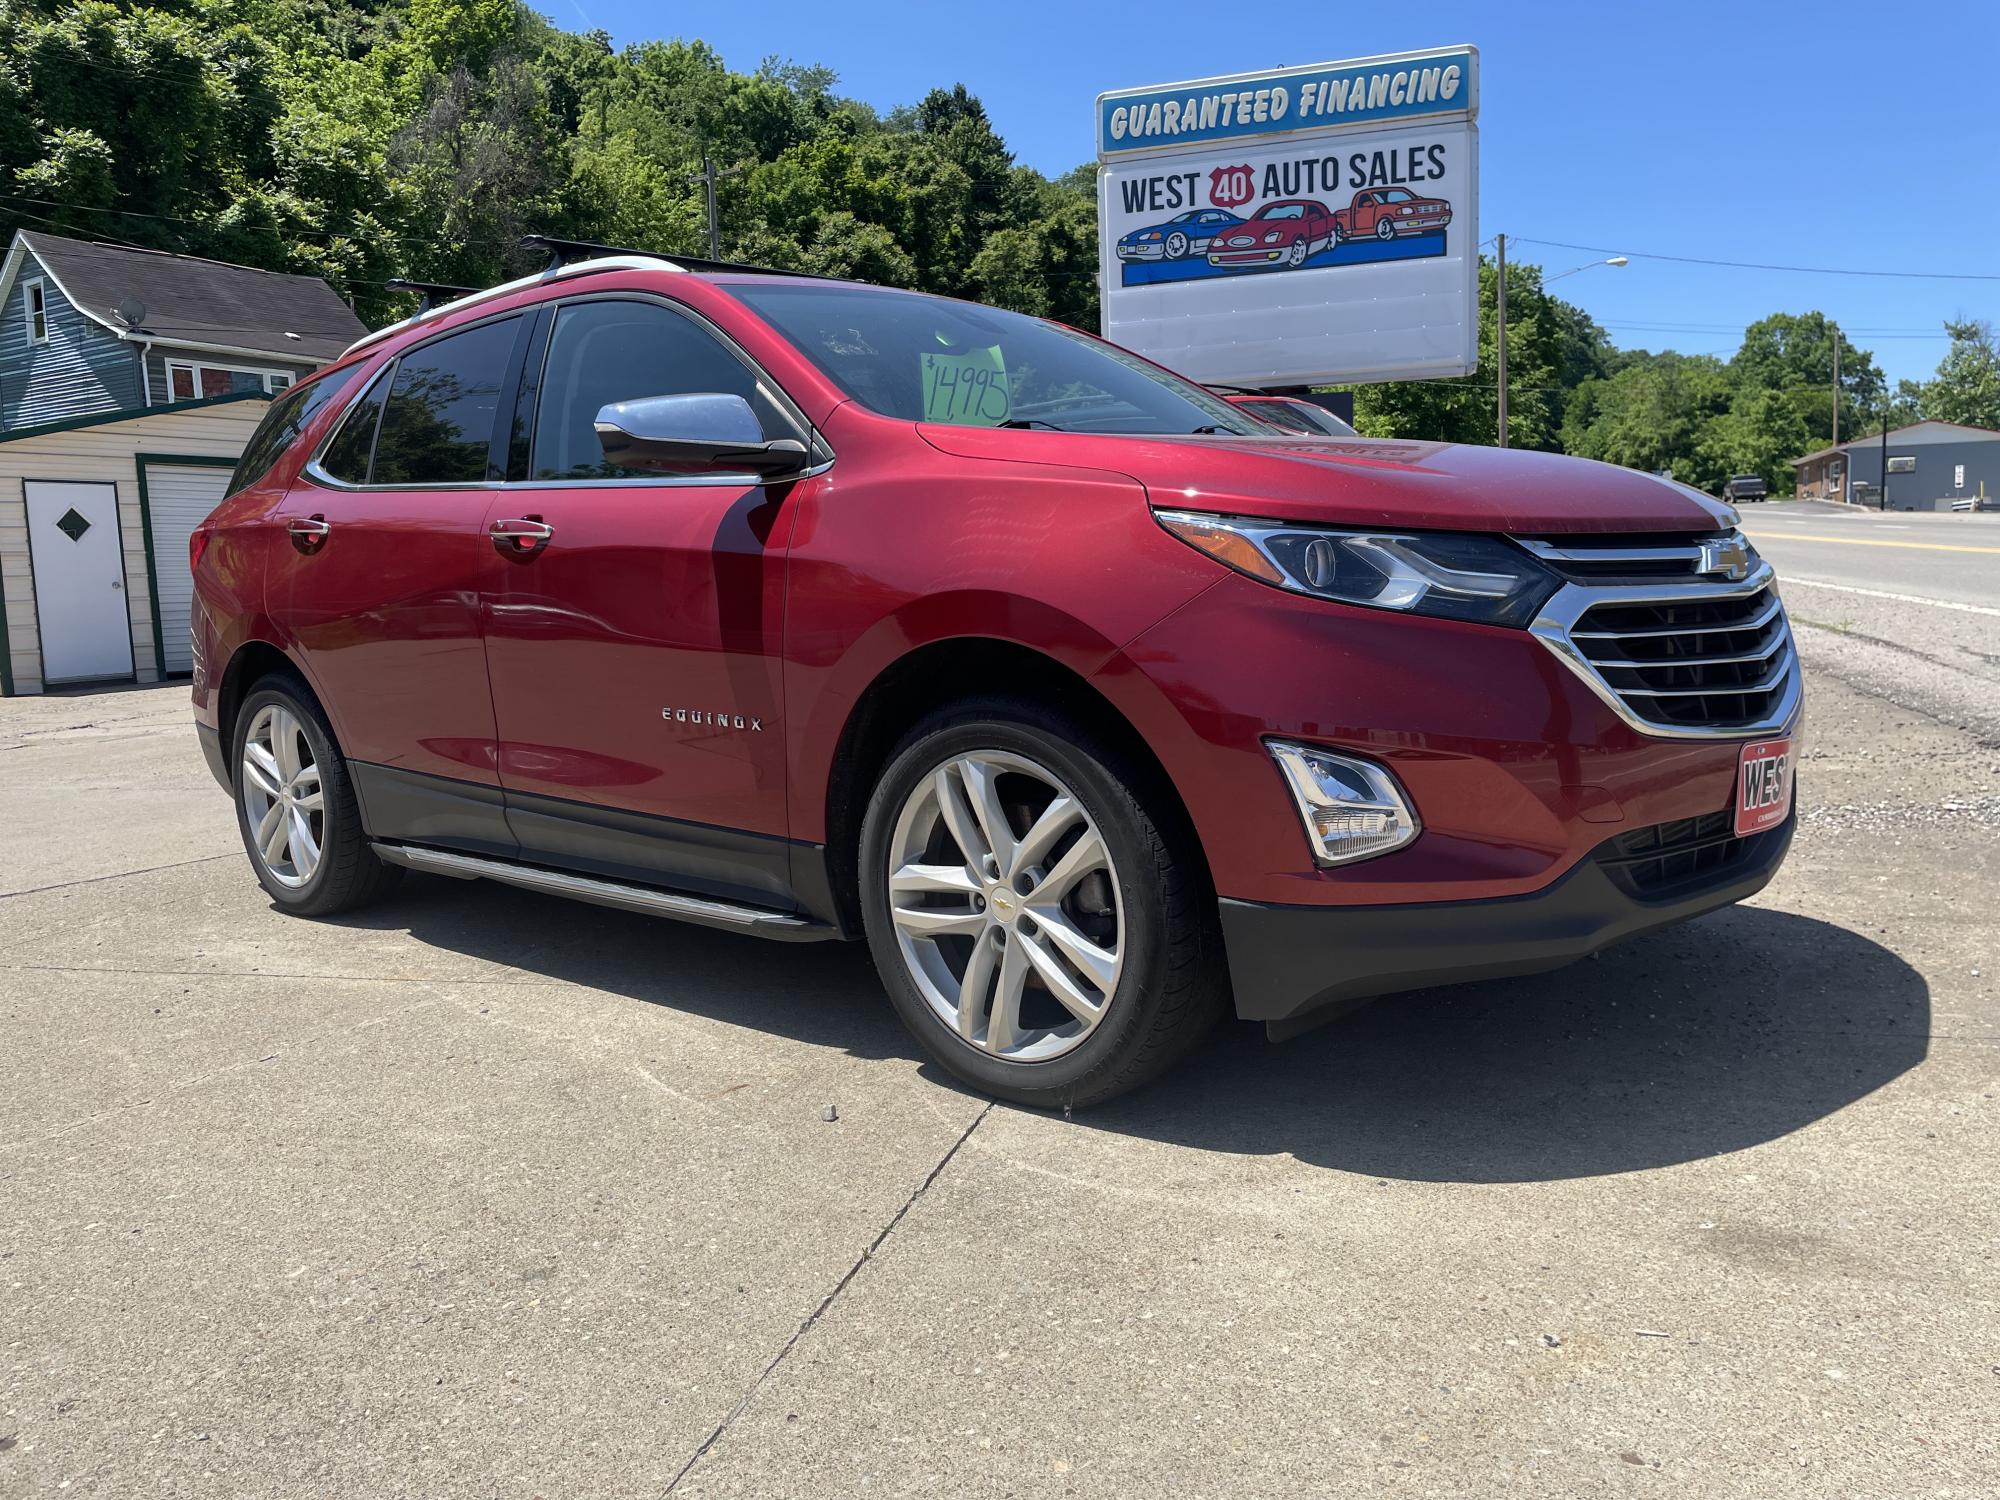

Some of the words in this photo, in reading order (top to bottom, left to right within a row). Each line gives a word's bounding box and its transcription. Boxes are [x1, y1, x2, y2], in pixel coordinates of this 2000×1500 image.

[1110, 87, 1289, 140] GUARANTEED
[1300, 65, 1461, 118] FINANCING
[1121, 172, 1200, 214] WEST
[1214, 173, 1247, 202] 40
[1262, 156, 1339, 198] AUTO
[1349, 144, 1446, 188] SALES
[662, 707, 762, 731] EQUINOX
